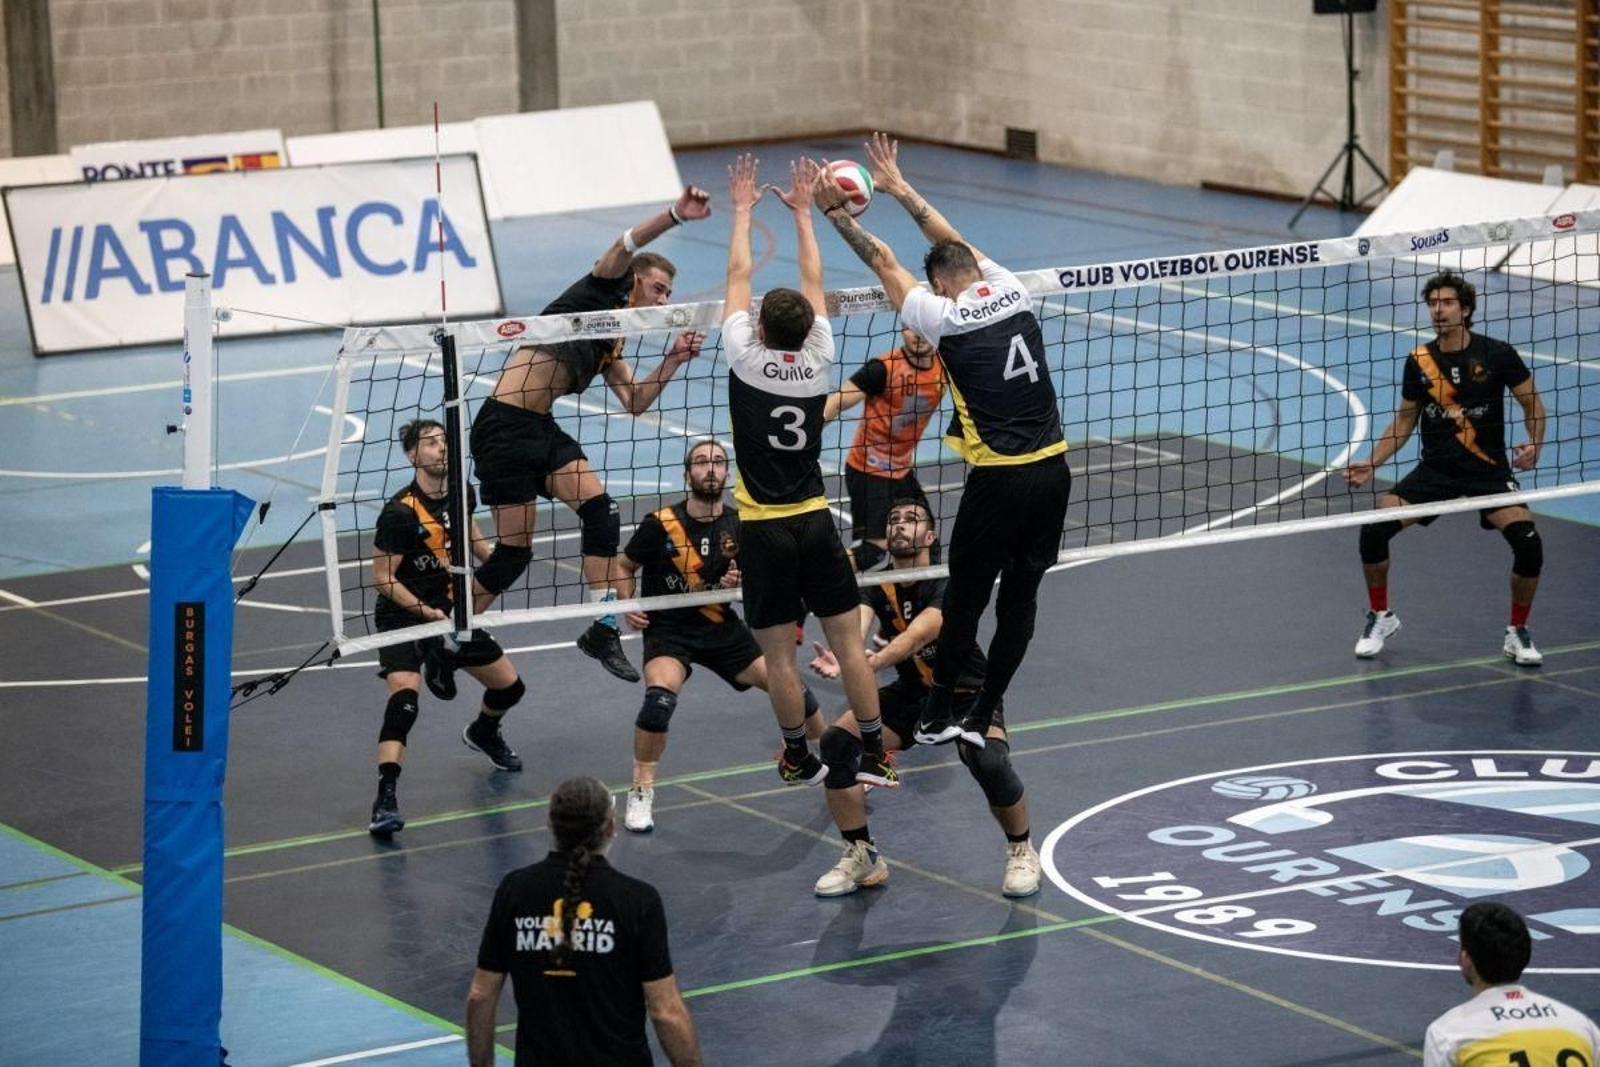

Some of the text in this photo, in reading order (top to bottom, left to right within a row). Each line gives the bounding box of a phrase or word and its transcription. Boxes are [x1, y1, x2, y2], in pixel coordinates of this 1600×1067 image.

[1060, 244, 1320, 288] CLUB VOLEIBOL OURENSE
[1003, 333, 1040, 384] 4
[763, 362, 814, 382] Guille
[1451, 367, 1461, 384] 5
[900, 374, 915, 397] 16
[767, 405, 808, 450] 3
[442, 511, 451, 529] 3
[700, 537, 710, 556] 6
[903, 601, 912, 619] 2
[183, 607, 195, 748] BURGAS VOLEI
[1148, 825, 1554, 940] OURENS
[1092, 871, 1317, 938] 1989
[1490, 1003, 1558, 1021] Rodri
